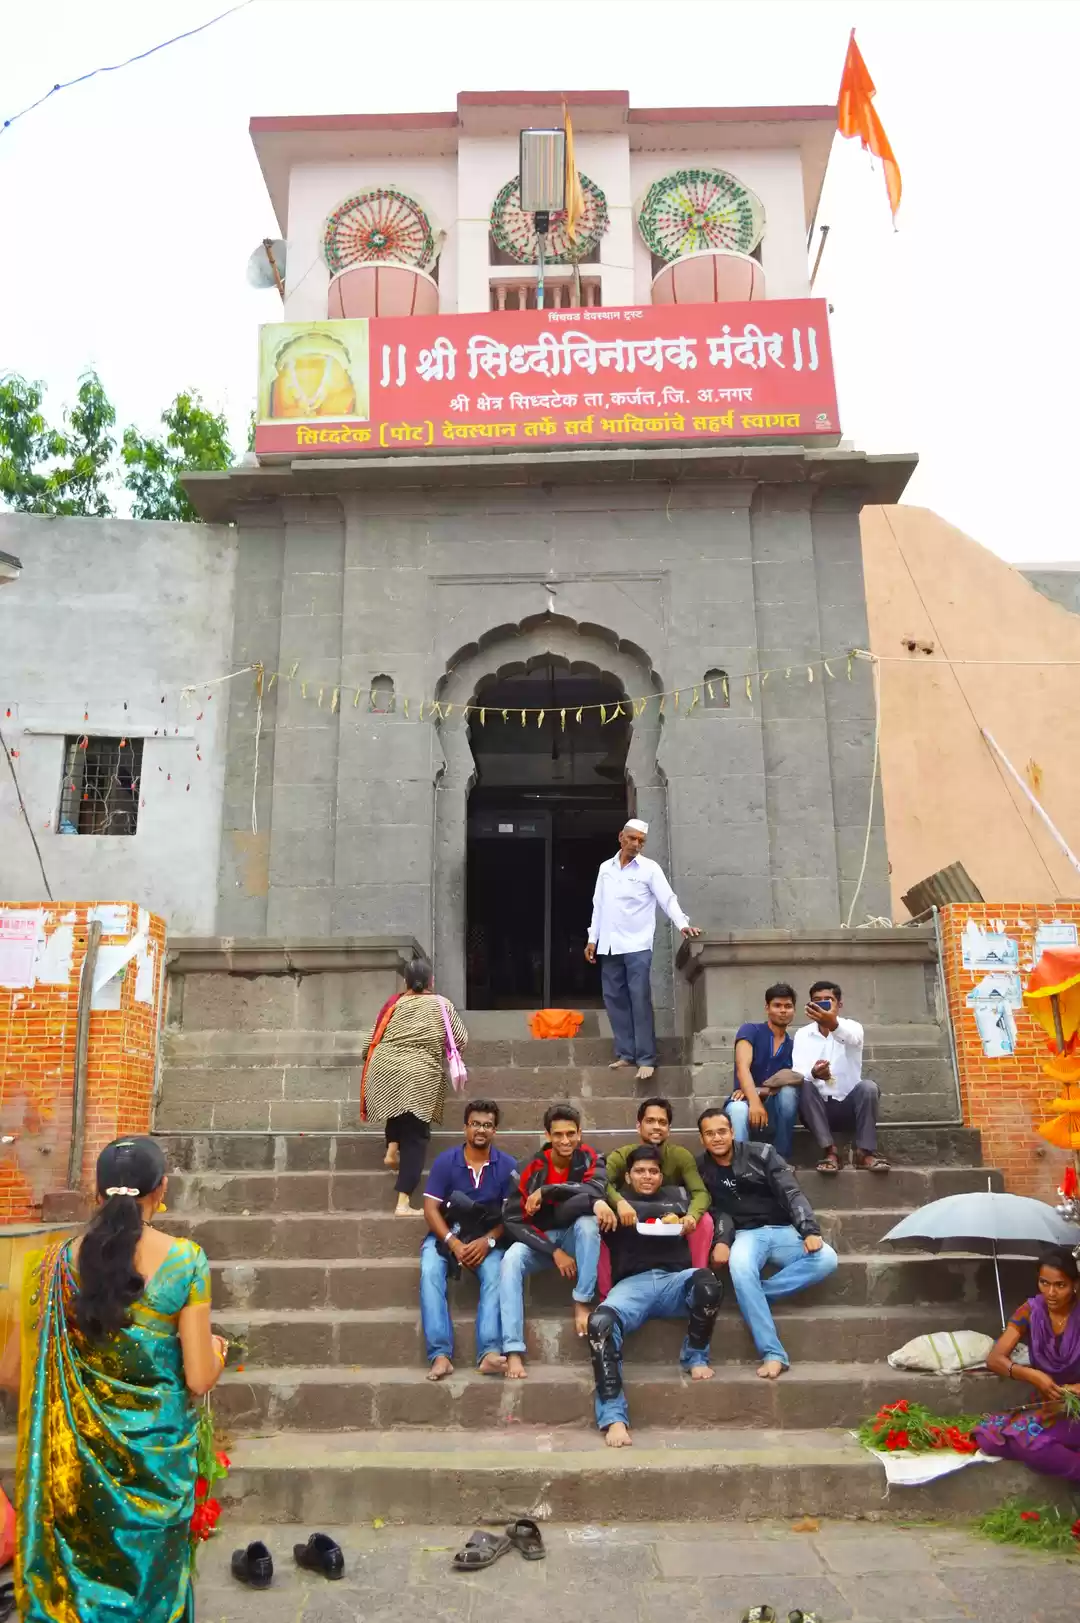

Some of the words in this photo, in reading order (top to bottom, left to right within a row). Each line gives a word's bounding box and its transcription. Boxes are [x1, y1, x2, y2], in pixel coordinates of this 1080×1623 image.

[584, 309, 620, 320] देवस्थान
[416, 336, 457, 382] श्री
[707, 323, 786, 370] मंदीर
[449, 394, 470, 413] श्री
[476, 392, 504, 411] क्षेत्र
[442, 420, 517, 440] देवस्थान
[524, 416, 557, 437] तर्फे
[564, 414, 595, 436] सर्व
[600, 411, 686, 434] भाविकांचे
[692, 409, 735, 433] सहर्ष
[741, 412, 800, 430] स्वागत
